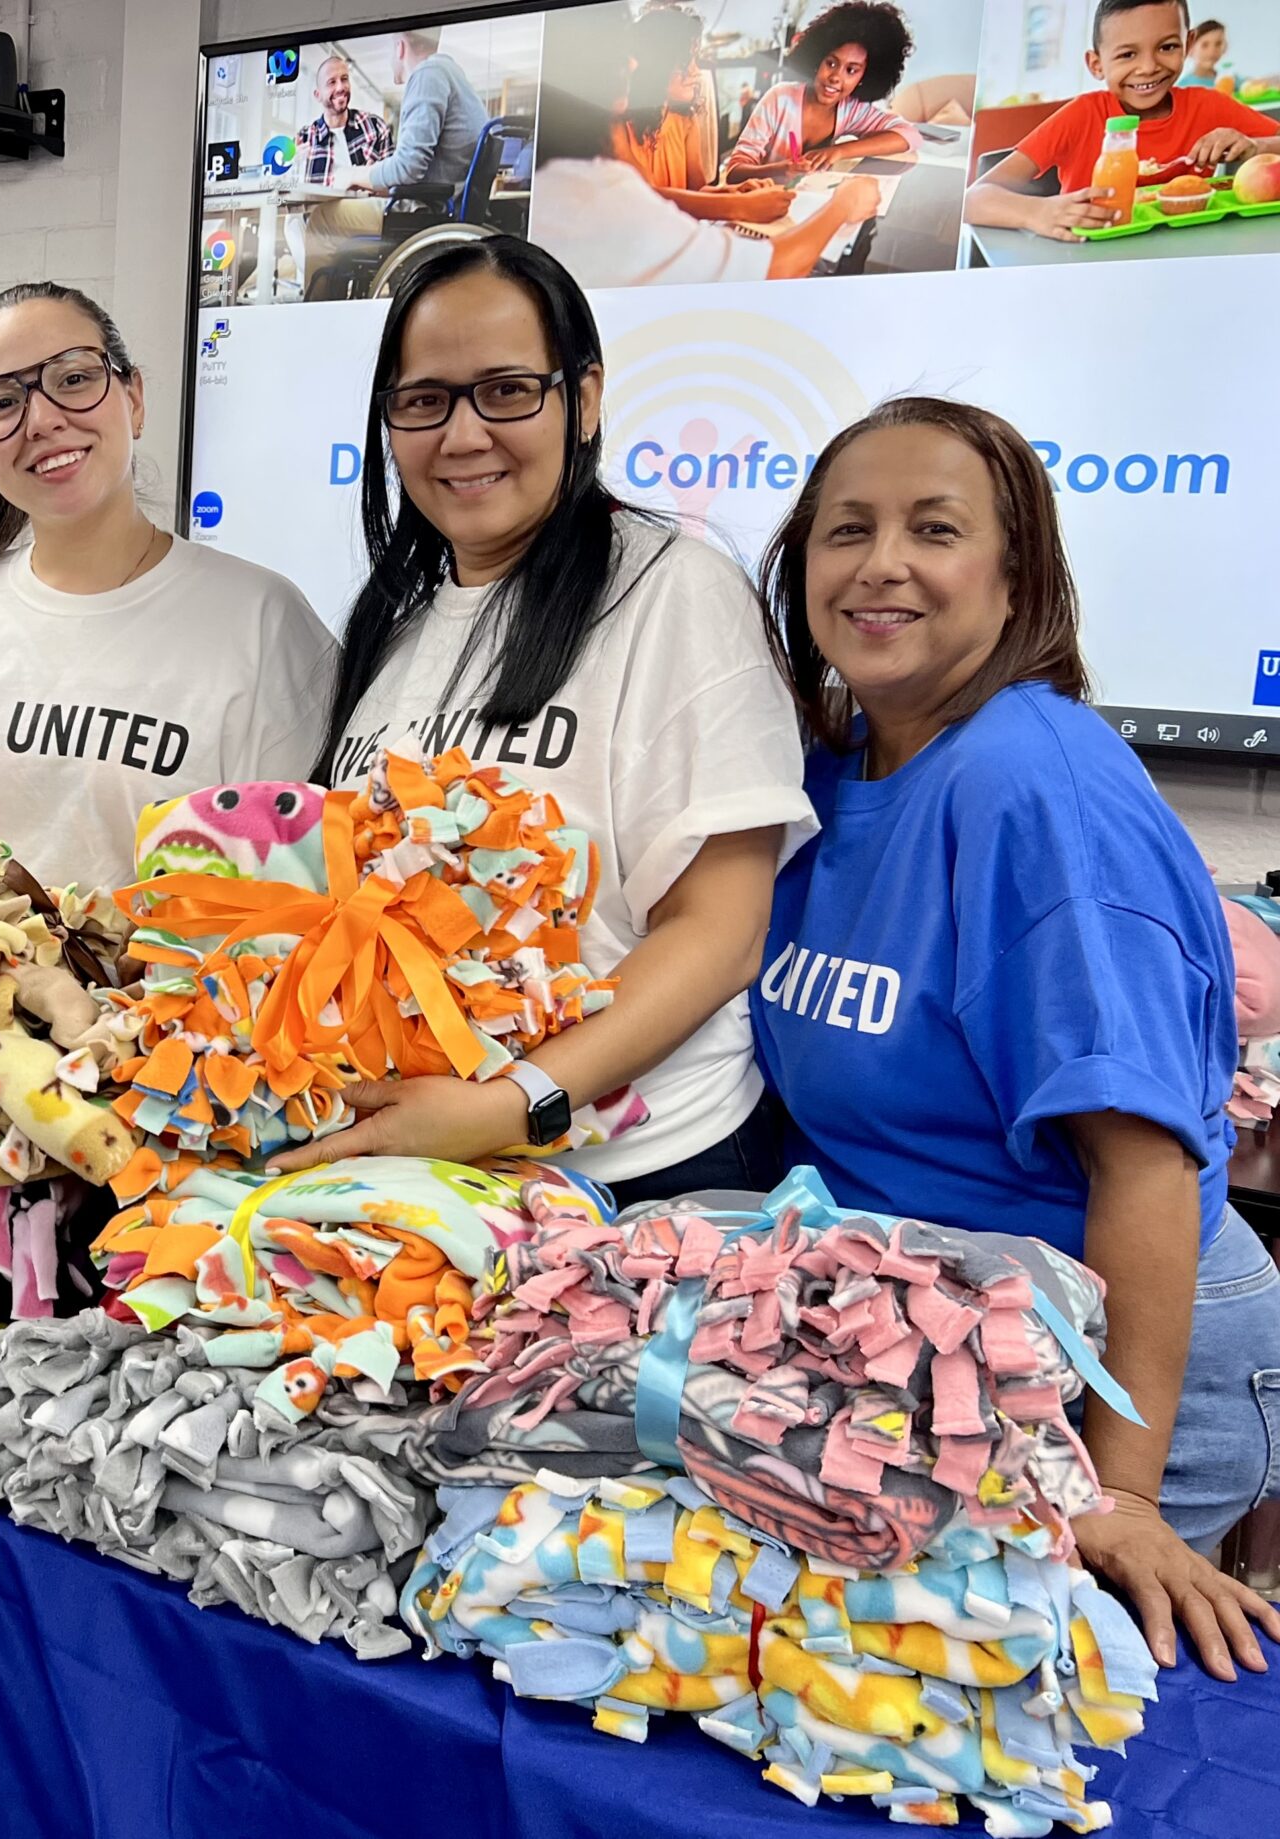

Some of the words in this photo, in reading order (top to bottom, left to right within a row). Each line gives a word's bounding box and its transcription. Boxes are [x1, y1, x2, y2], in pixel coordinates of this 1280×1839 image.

[1028, 440, 1230, 494] Room
[6, 701, 189, 777] UNITED
[333, 723, 390, 789] IVE
[407, 705, 578, 769] NITED
[760, 941, 901, 1035] UNITED
